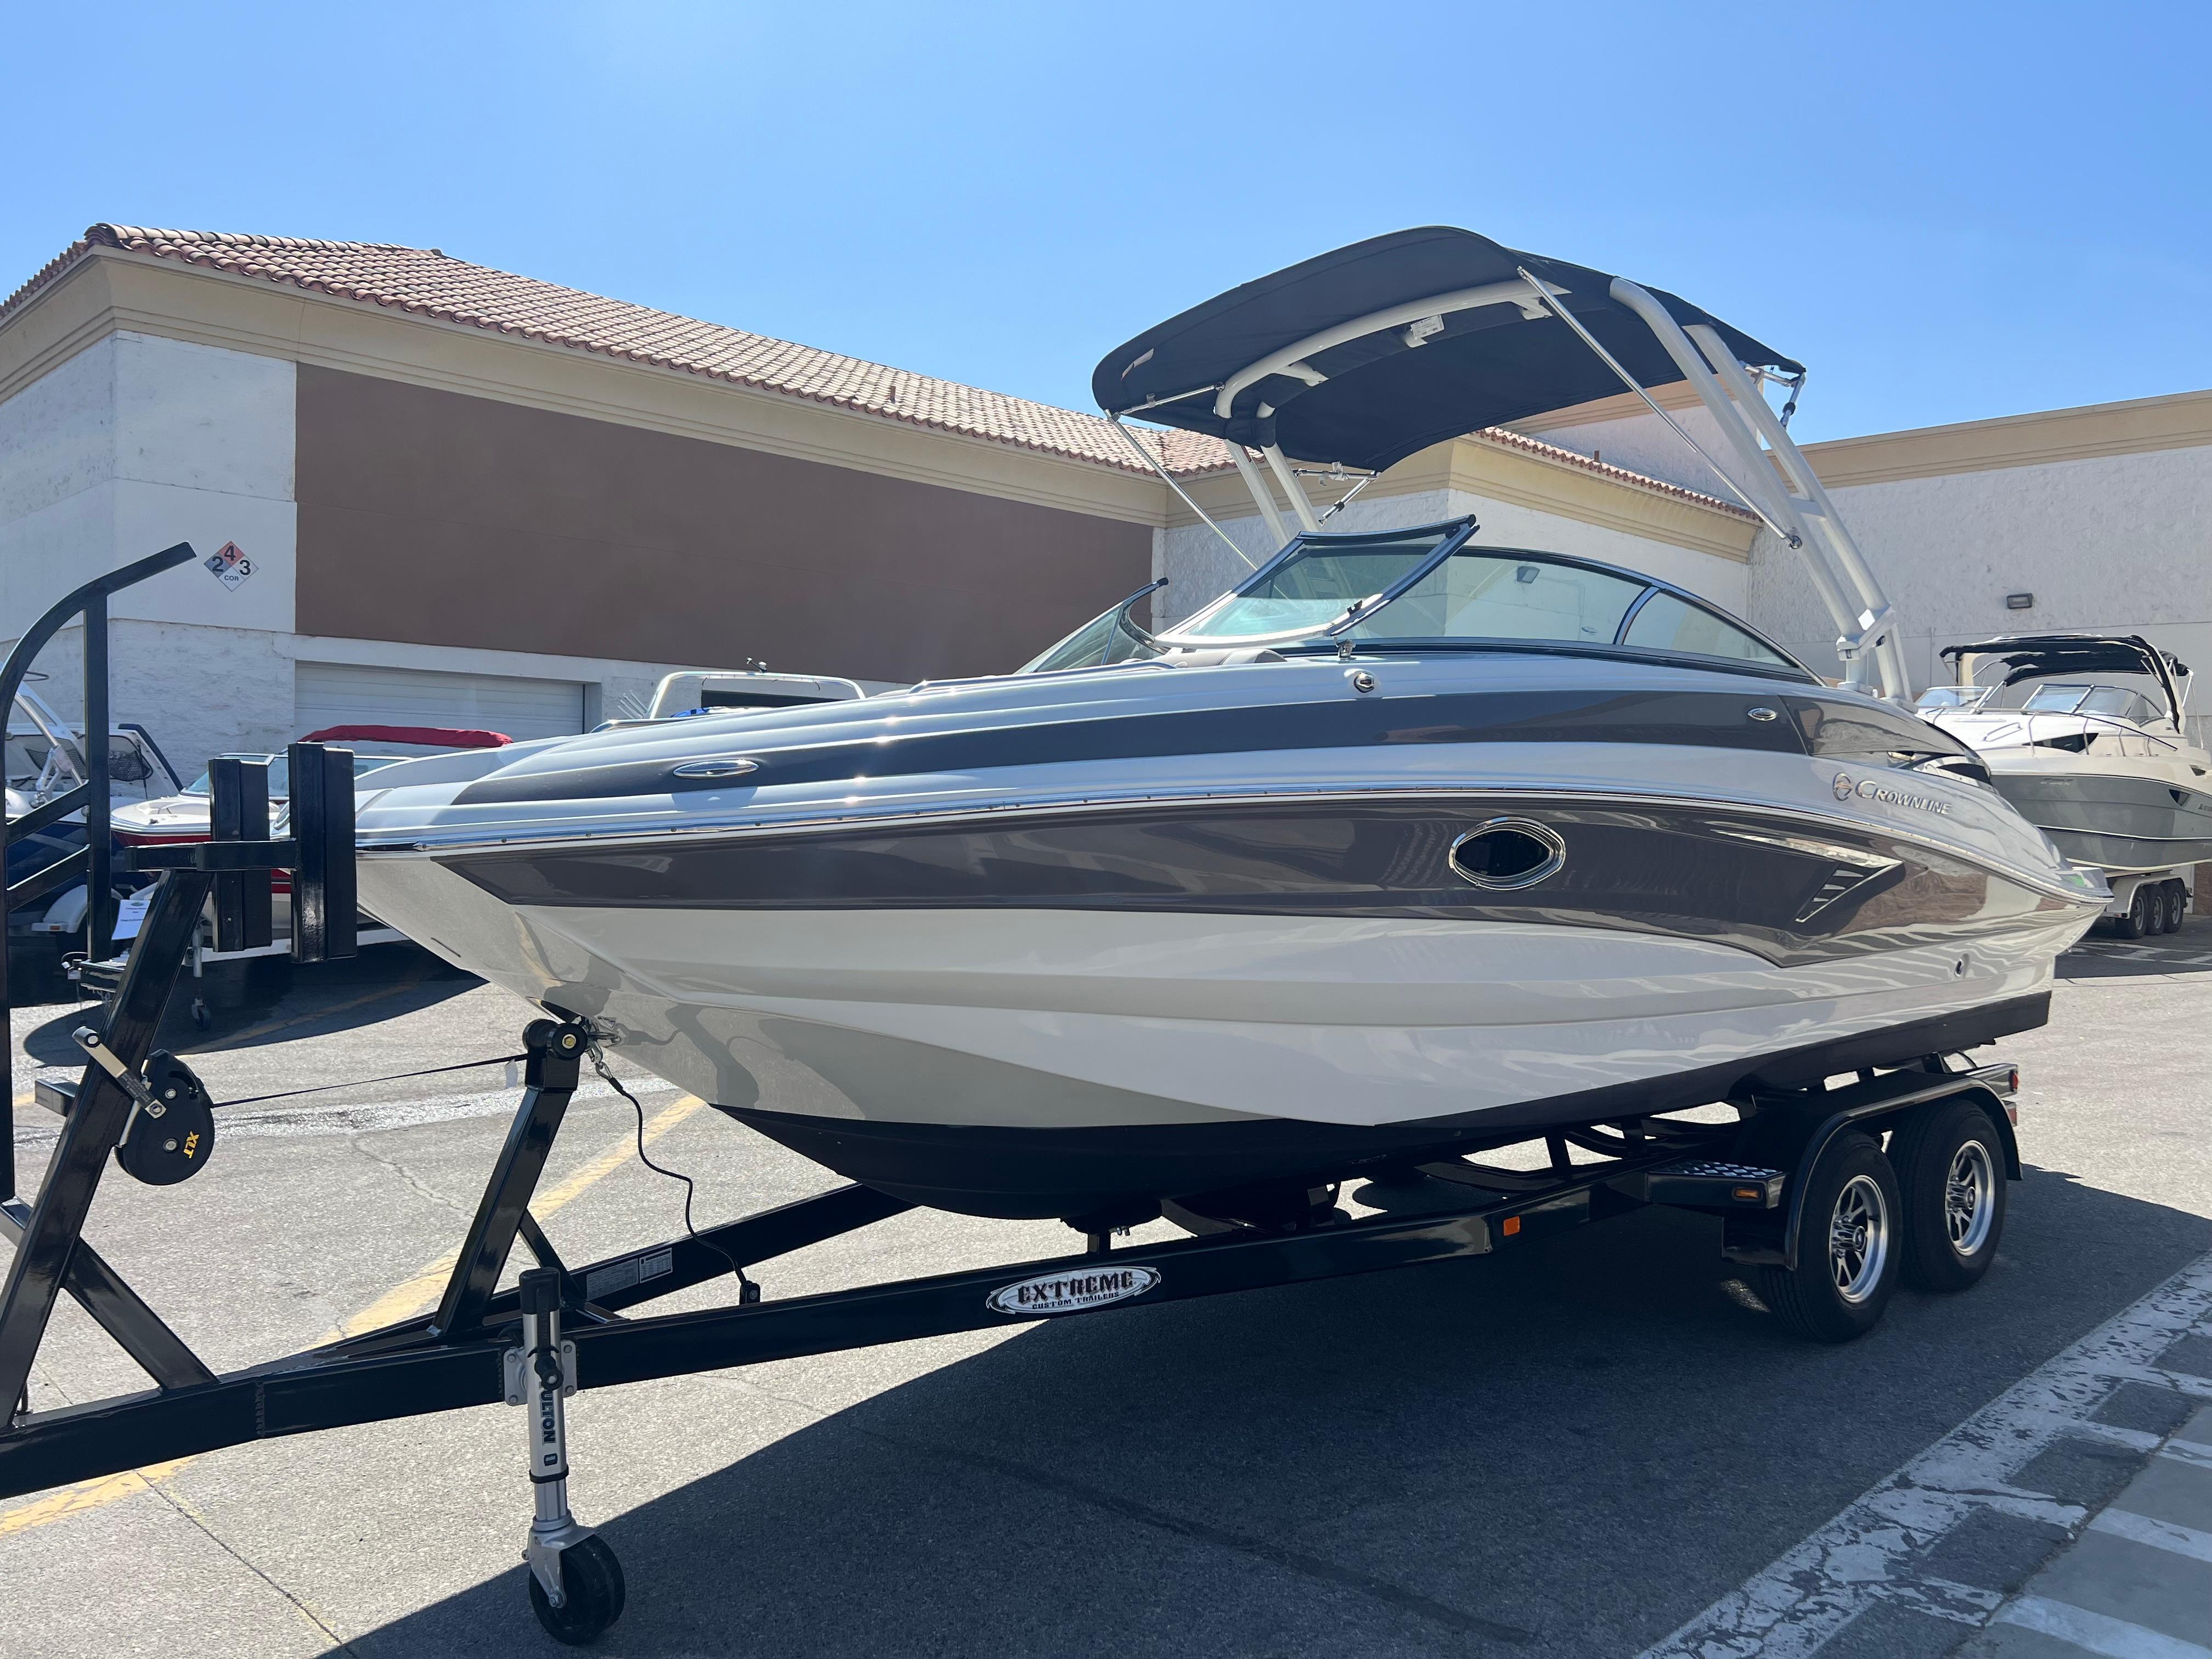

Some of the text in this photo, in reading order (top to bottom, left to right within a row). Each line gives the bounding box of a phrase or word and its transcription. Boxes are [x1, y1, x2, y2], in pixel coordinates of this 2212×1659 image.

[224, 545, 236, 561] 4
[212, 556, 224, 572] 2
[239, 560, 251, 575] 3
[183, 1131, 200, 1159] XLT
[1018, 1271, 1134, 1305] EXTREME
[1032, 1291, 1120, 1310] CUSTOM TRAILERS
[539, 1381, 556, 1445] ULTON
